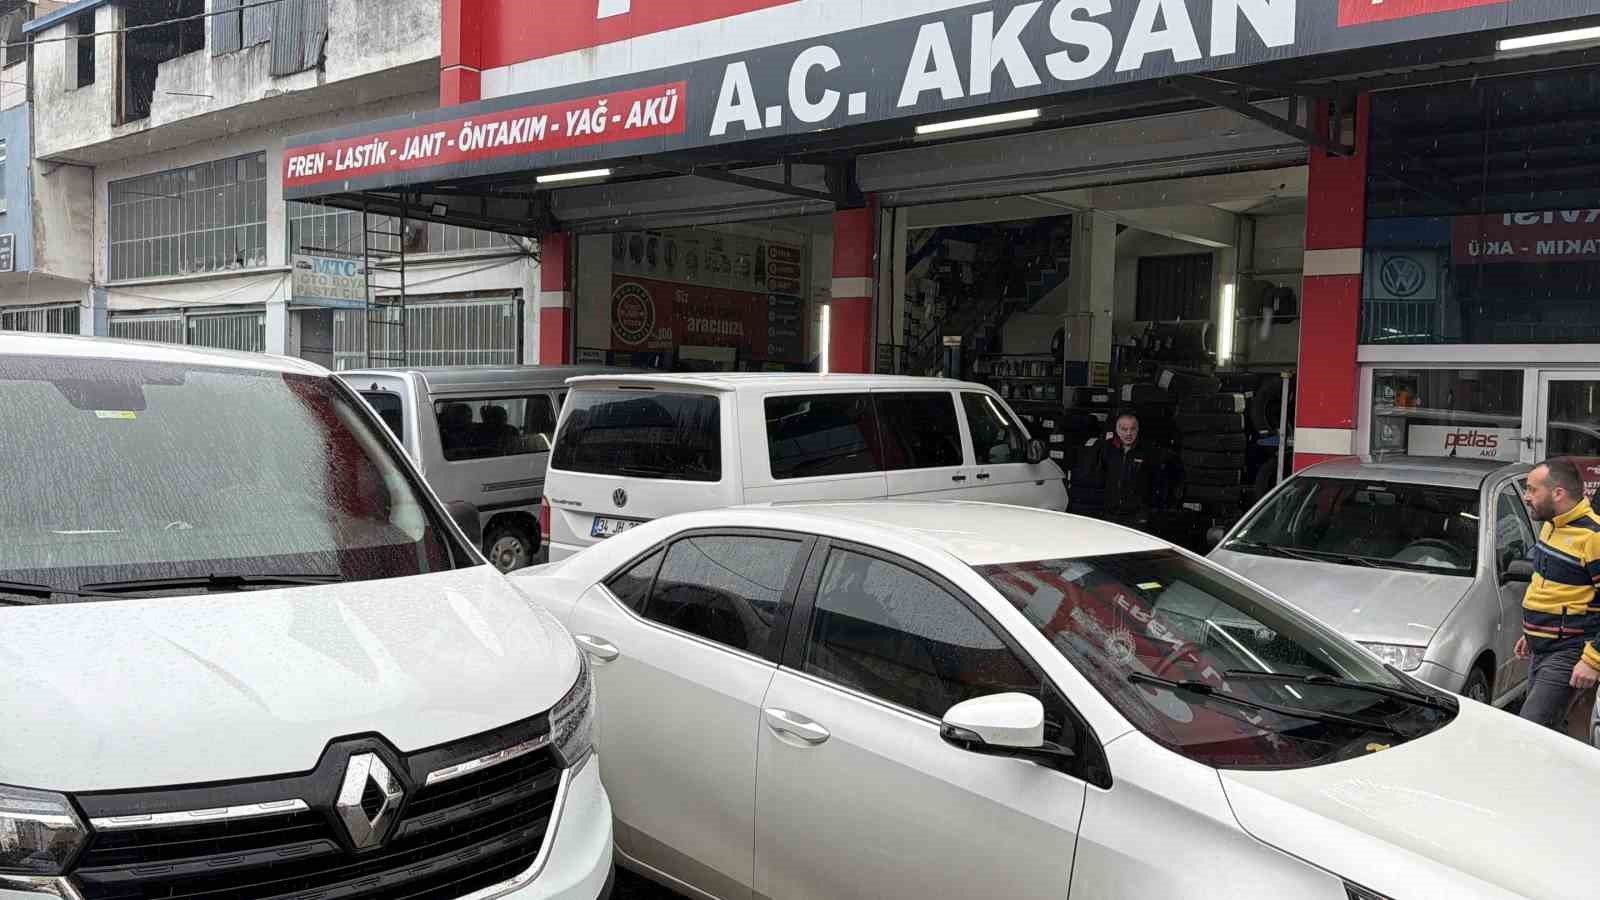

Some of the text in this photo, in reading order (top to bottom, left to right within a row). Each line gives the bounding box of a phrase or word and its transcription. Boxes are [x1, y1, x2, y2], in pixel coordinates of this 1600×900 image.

[709, 0, 1296, 136] A.C. AKSAN
[288, 152, 325, 178] FREN
[335, 138, 389, 171] LASTİK
[399, 131, 446, 161] JANT
[458, 121, 548, 152] ÖNTAKIM
[565, 100, 608, 137] YAĞ
[624, 89, 679, 129] AKÜ
[311, 258, 357, 277] MTC
[1445, 429, 1498, 449] petlas
